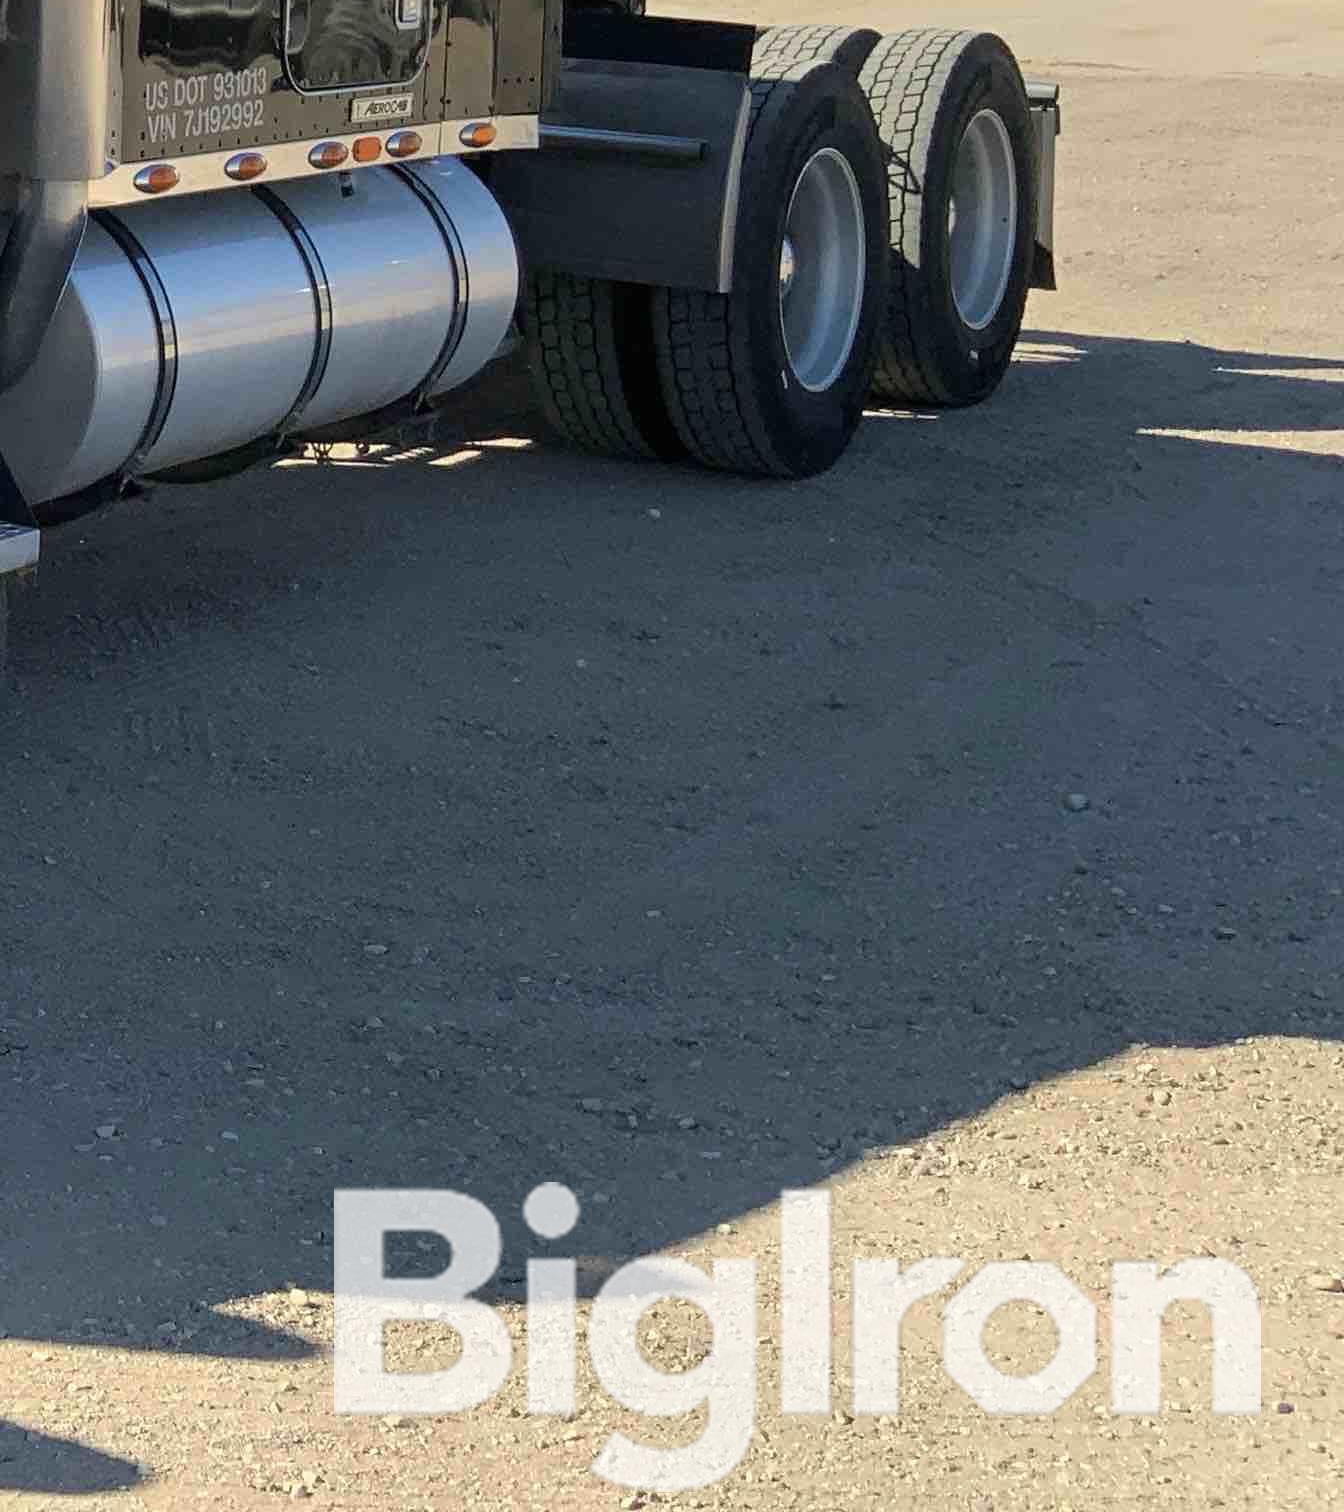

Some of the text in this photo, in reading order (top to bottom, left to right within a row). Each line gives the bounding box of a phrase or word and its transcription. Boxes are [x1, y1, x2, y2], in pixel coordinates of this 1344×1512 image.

[145, 67, 267, 110] US DOT 931013
[147, 112, 177, 143] VIN
